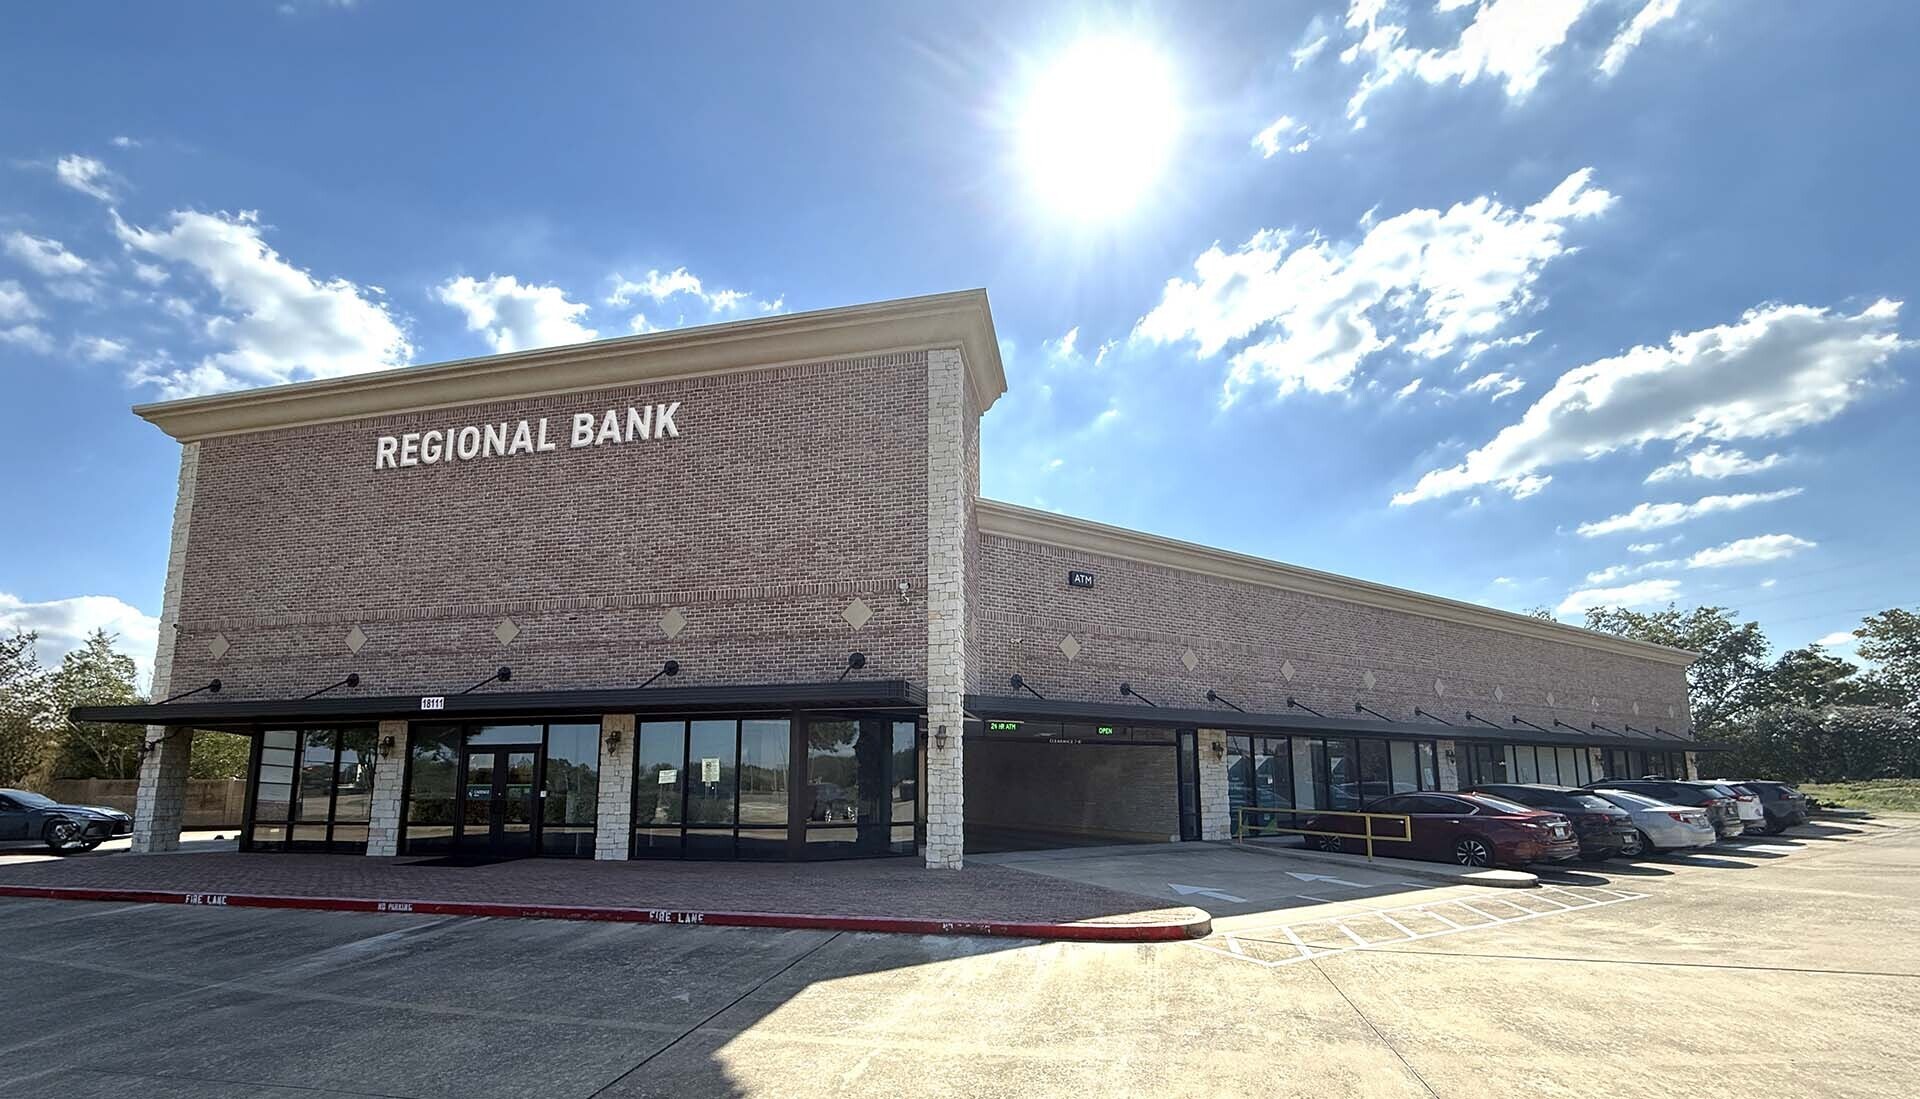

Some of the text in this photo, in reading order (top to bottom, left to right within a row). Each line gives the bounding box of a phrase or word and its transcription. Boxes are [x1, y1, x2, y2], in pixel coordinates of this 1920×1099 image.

[375, 402, 681, 470] REGIONAL BANK
[1074, 574, 1092, 584] ATM
[423, 699, 443, 708] 18111
[990, 722, 998, 730] 24
[1005, 723, 1016, 731] ATM
[1098, 727, 1113, 735] OPEN
[185, 894, 227, 905] FIRE LANE
[650, 911, 704, 923] FIRE LANE
